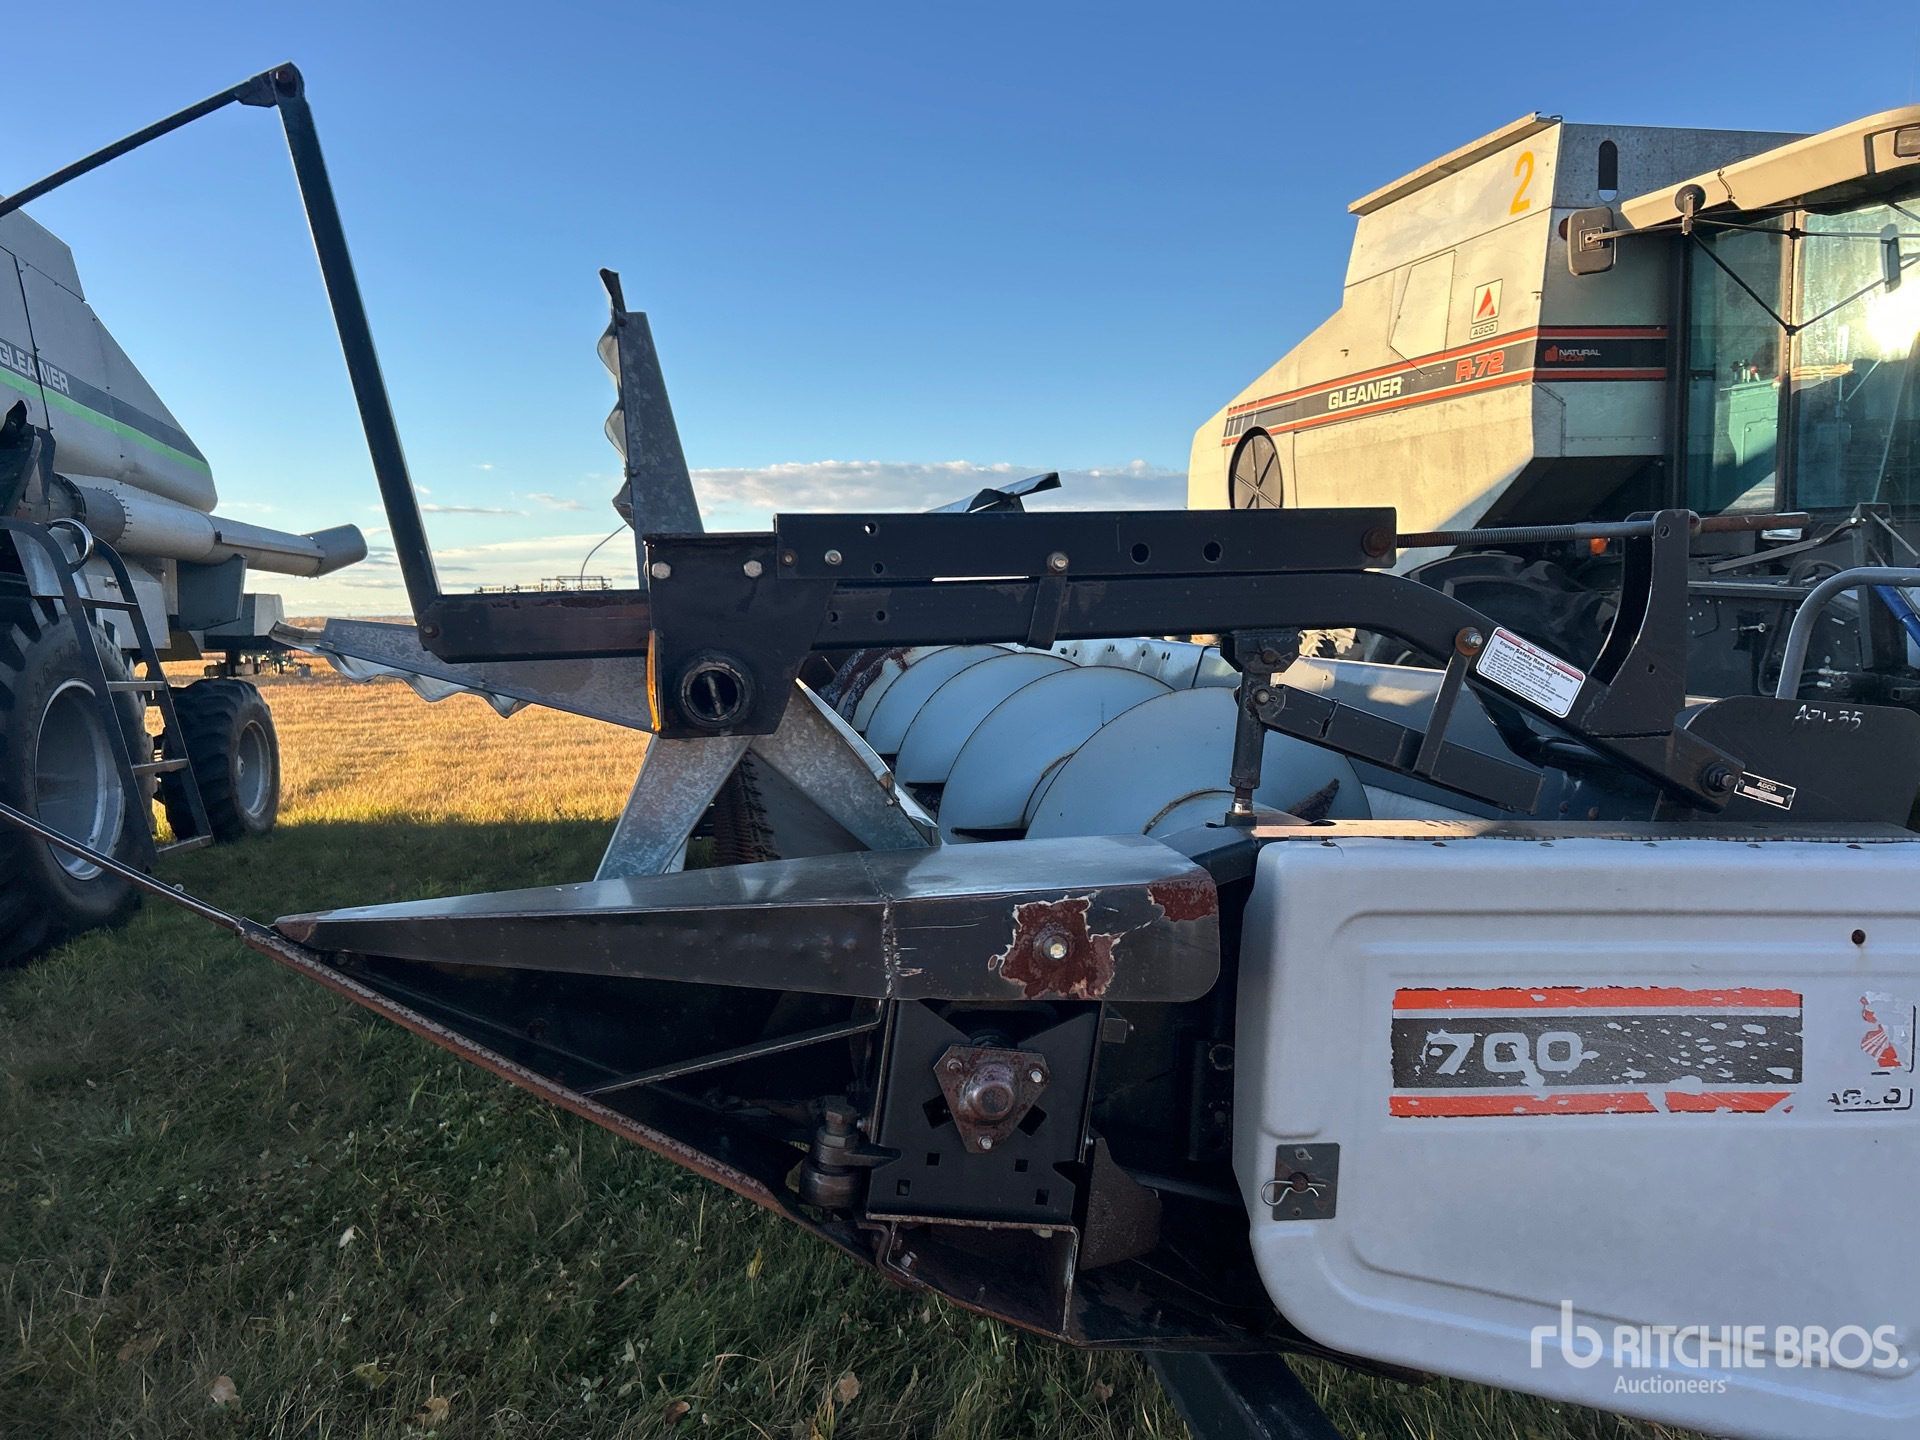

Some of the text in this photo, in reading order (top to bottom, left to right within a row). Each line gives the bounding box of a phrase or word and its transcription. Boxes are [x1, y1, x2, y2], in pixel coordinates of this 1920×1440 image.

[1510, 151, 1534, 215] 2
[1473, 324, 1495, 336] AGCO
[0, 341, 70, 395] GLEANER
[1328, 350, 1505, 410] GLEANER R-72
[1515, 648, 1533, 661] Safety
[1532, 658, 1545, 667] Ram
[1544, 664, 1560, 676] Stops
[1757, 781, 1777, 791] AGCO
